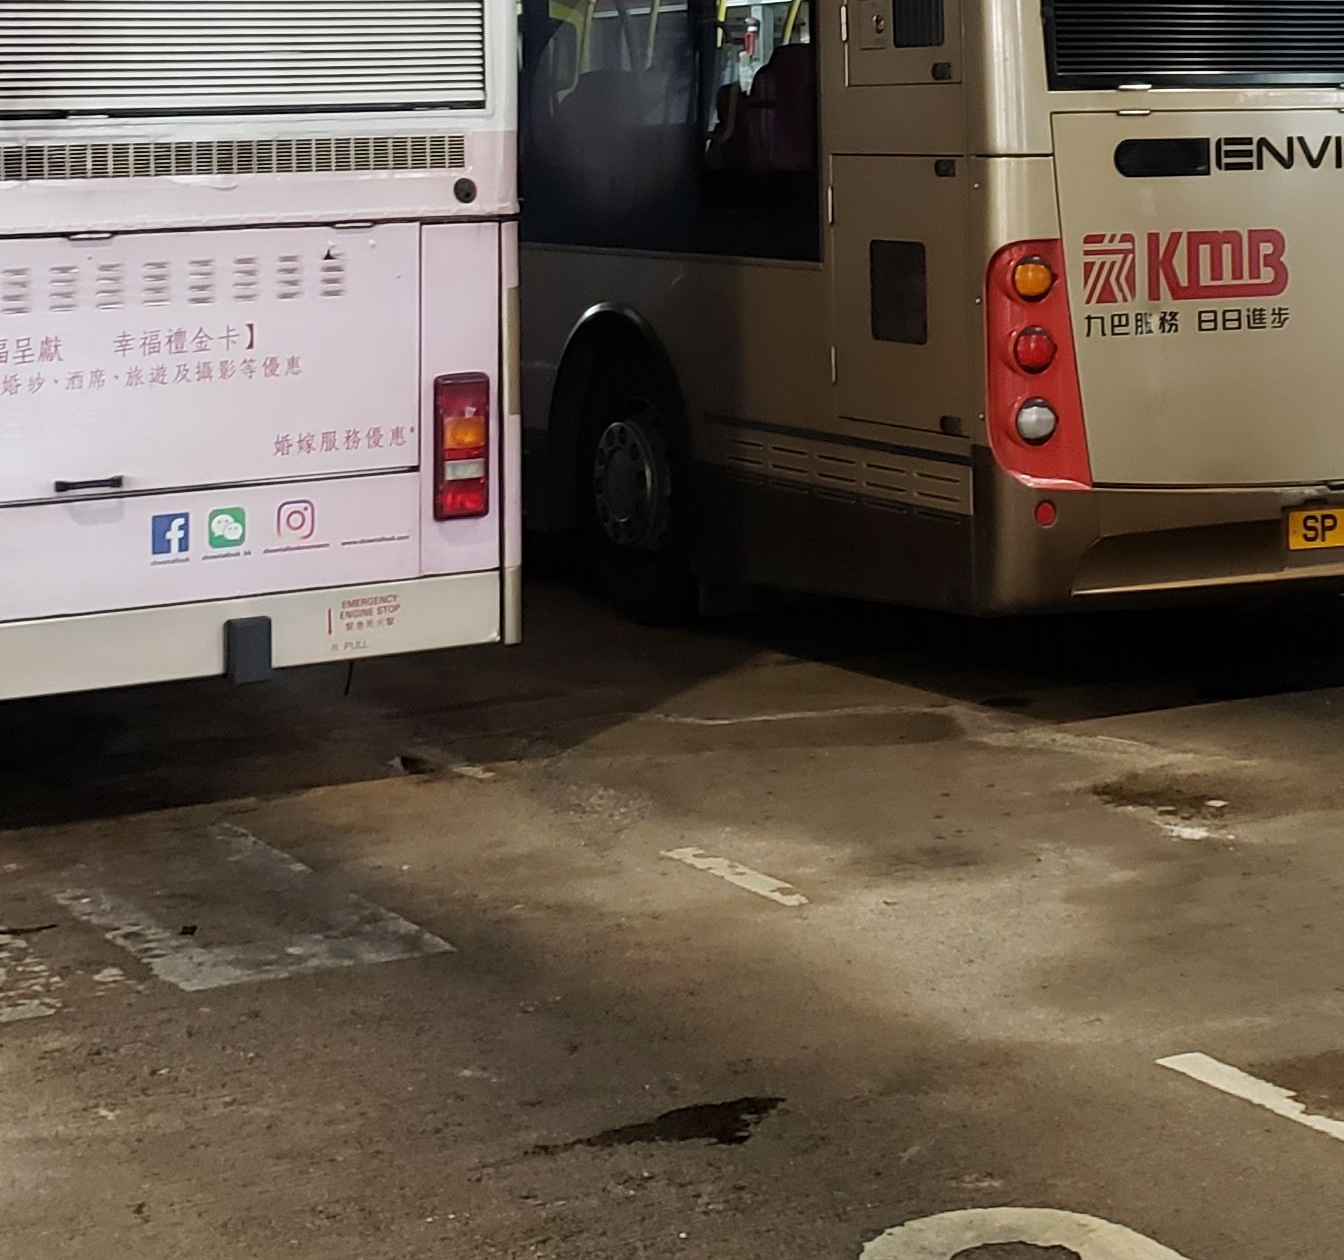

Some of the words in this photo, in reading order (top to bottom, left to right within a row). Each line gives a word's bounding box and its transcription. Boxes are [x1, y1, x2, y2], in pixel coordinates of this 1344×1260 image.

[1147, 229, 1289, 301] KMB
[1084, 311, 1180, 337] 九巴服務
[1197, 307, 1290, 332] 日日進步
[1302, 514, 1338, 542] SP
[342, 594, 398, 609] EMERGENCY
[376, 604, 400, 615] STOP
